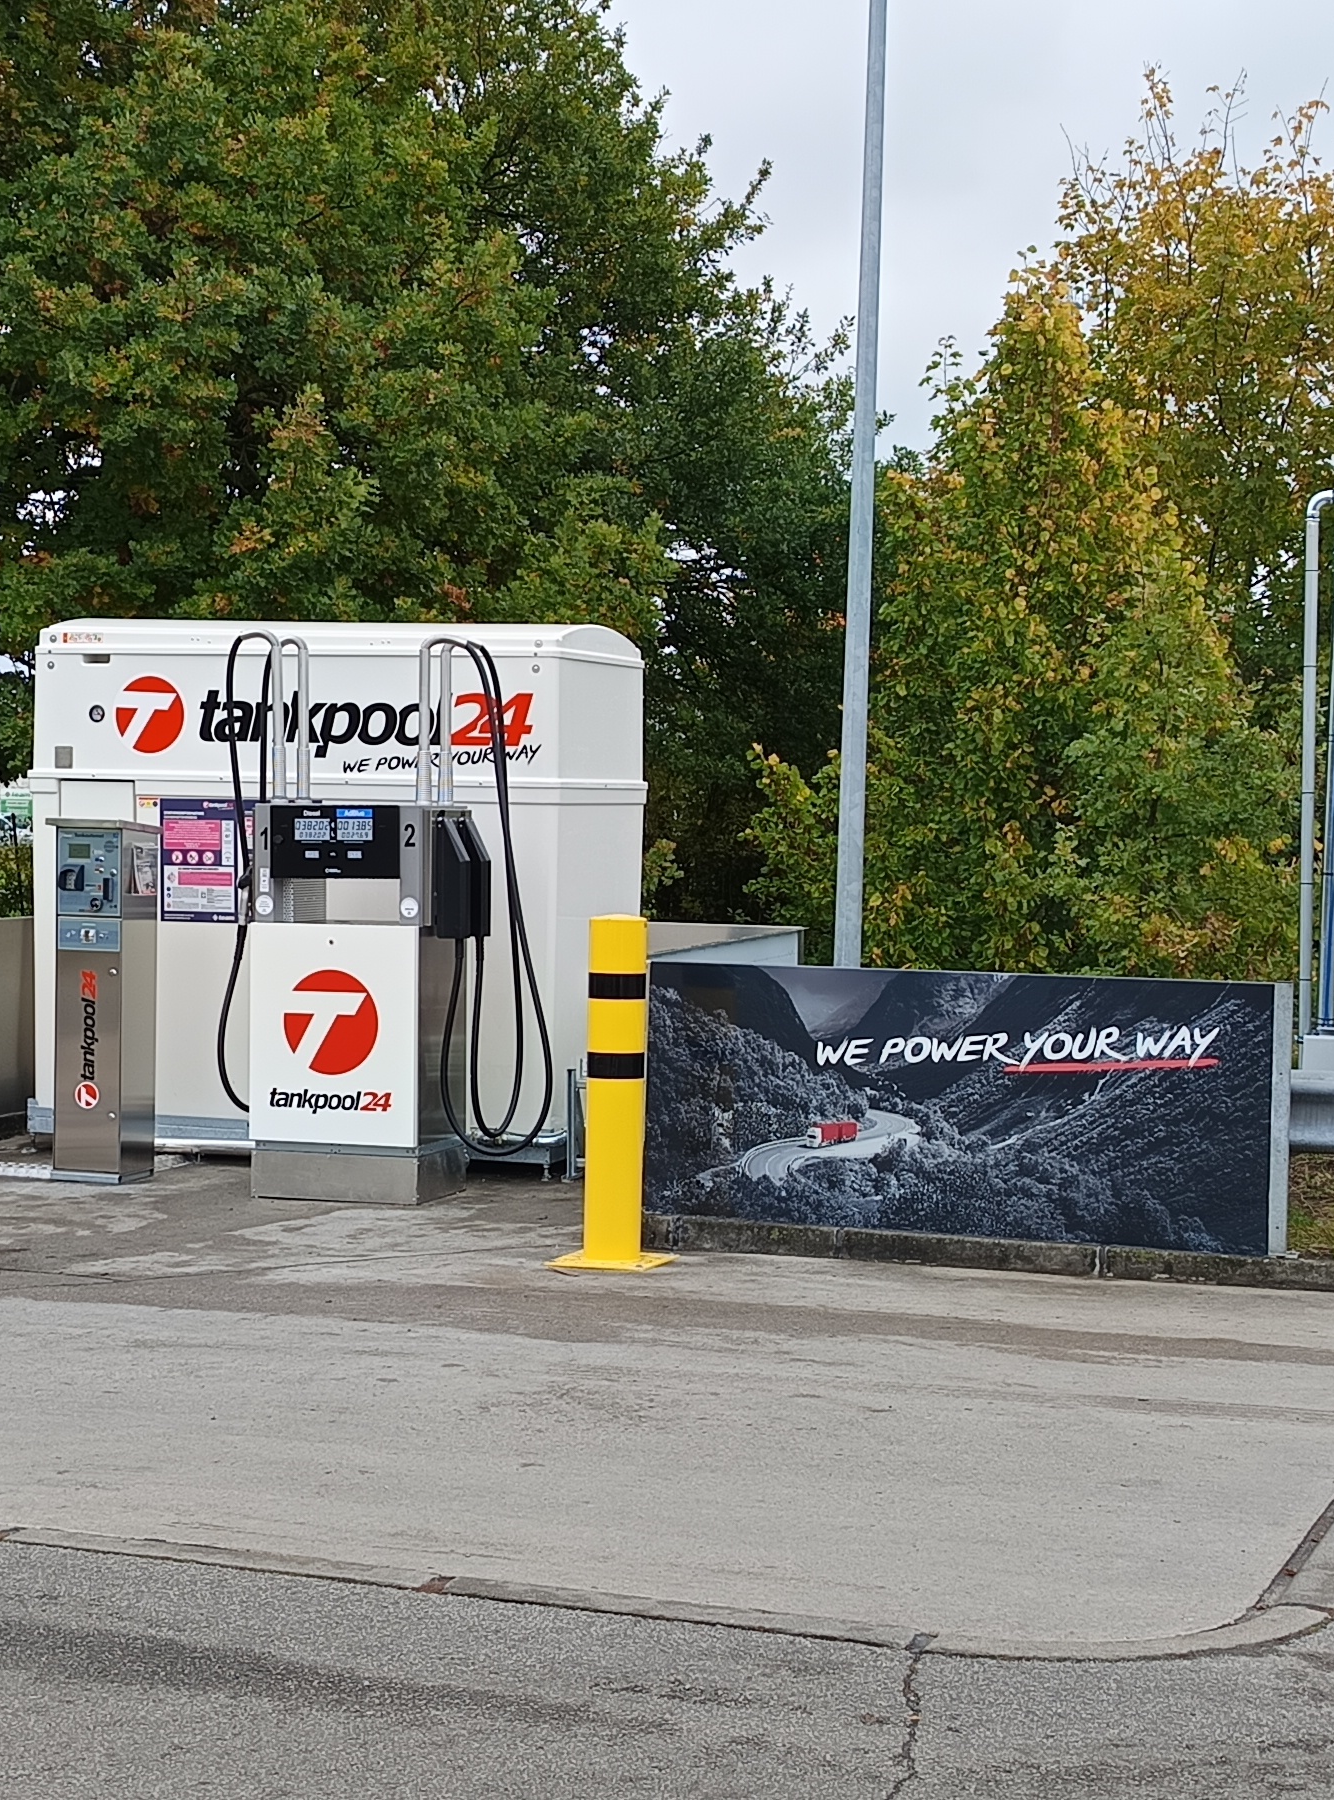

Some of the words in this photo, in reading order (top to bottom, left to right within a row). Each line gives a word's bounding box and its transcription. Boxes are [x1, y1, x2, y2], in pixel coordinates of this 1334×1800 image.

[342, 757, 372, 774] WE
[374, 752, 441, 771] POWR
[260, 826, 269, 850] 1
[404, 823, 416, 848] 2
[80, 970, 99, 1081] tankpool24
[815, 1035, 874, 1067] WE
[878, 1031, 1020, 1065] POWER
[1018, 1024, 1130, 1071] YOUR
[1135, 1024, 1221, 1067] WAY
[269, 1087, 392, 1115] tankpool24
